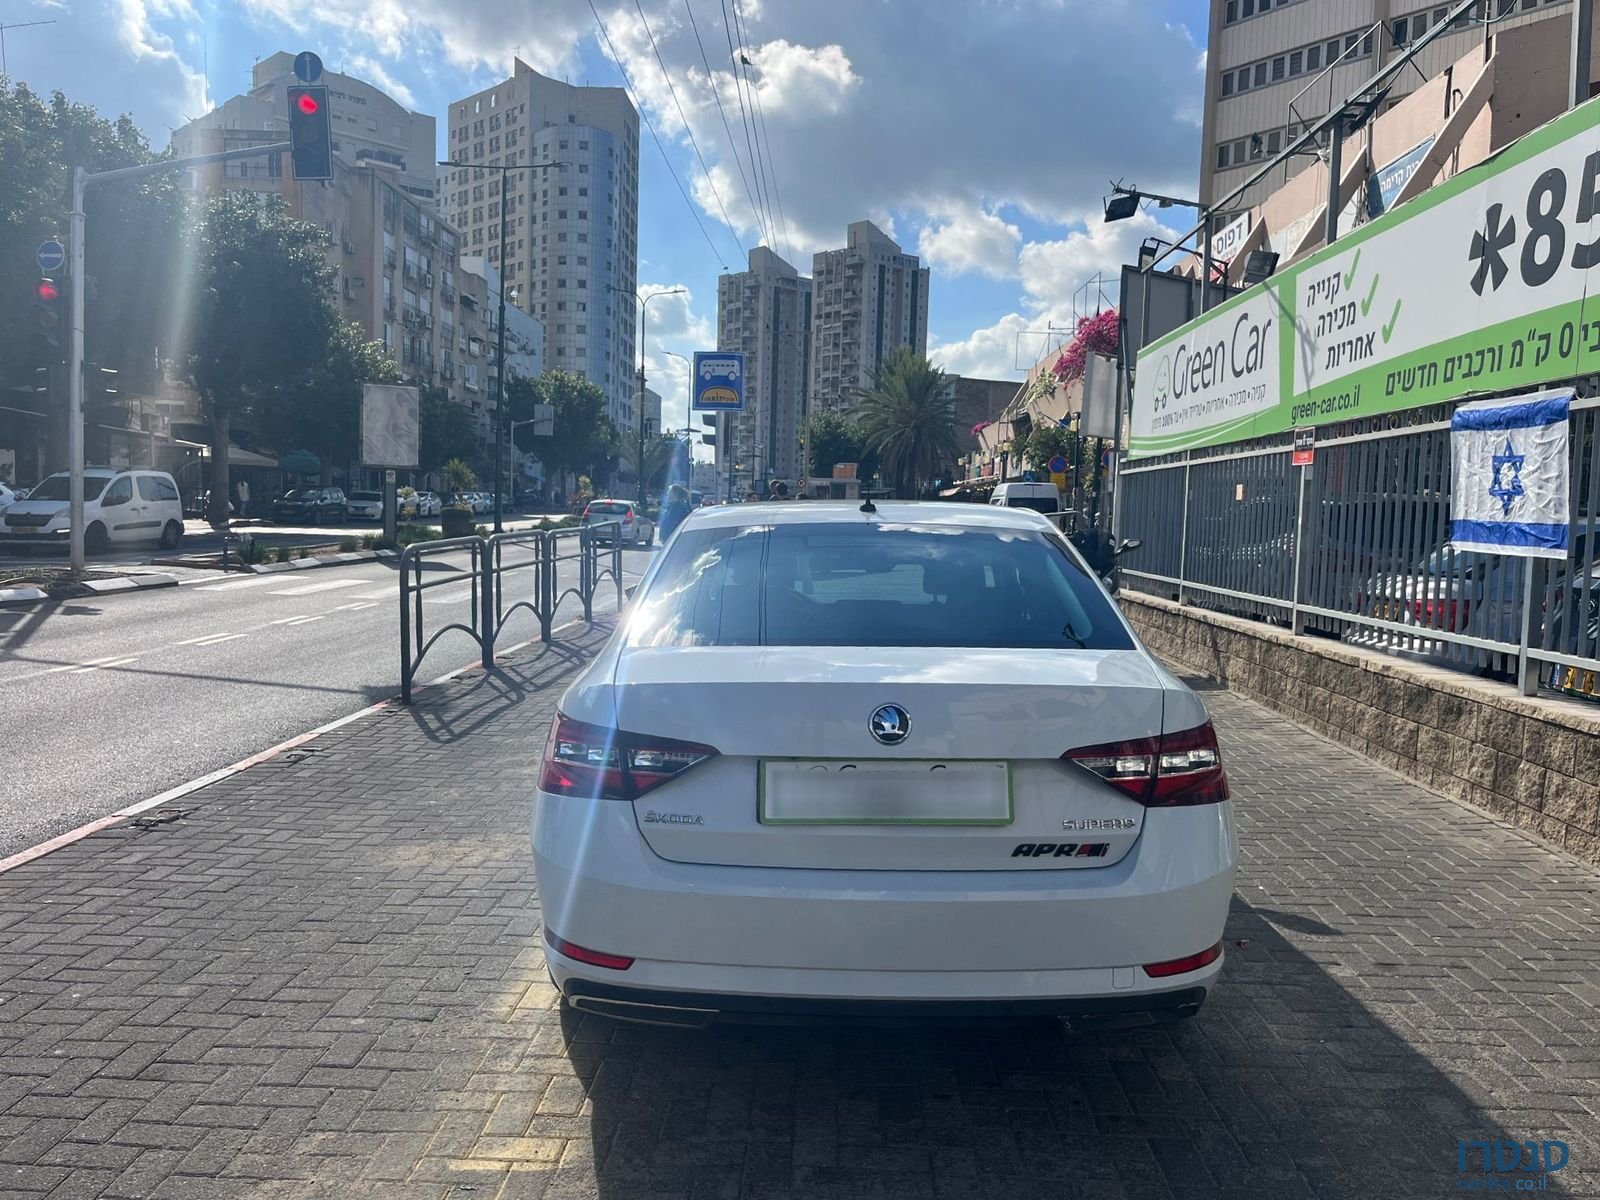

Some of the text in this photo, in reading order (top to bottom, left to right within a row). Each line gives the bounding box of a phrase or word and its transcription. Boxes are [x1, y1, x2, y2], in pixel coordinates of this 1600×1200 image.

[1216, 222, 1243, 255] דפוס
[1306, 271, 1341, 308] קנייה
[1316, 300, 1356, 338] מכירה
[1173, 312, 1271, 400] Green Car
[1325, 331, 1376, 370] אחריות
[1443, 343, 1504, 384] ורכבים
[1385, 360, 1438, 396] חדשים
[1290, 384, 1361, 421] green-car.co.il
[643, 810, 705, 826] ŠKODA
[1062, 817, 1136, 831] SUPERB
[1011, 843, 1079, 858] APR
